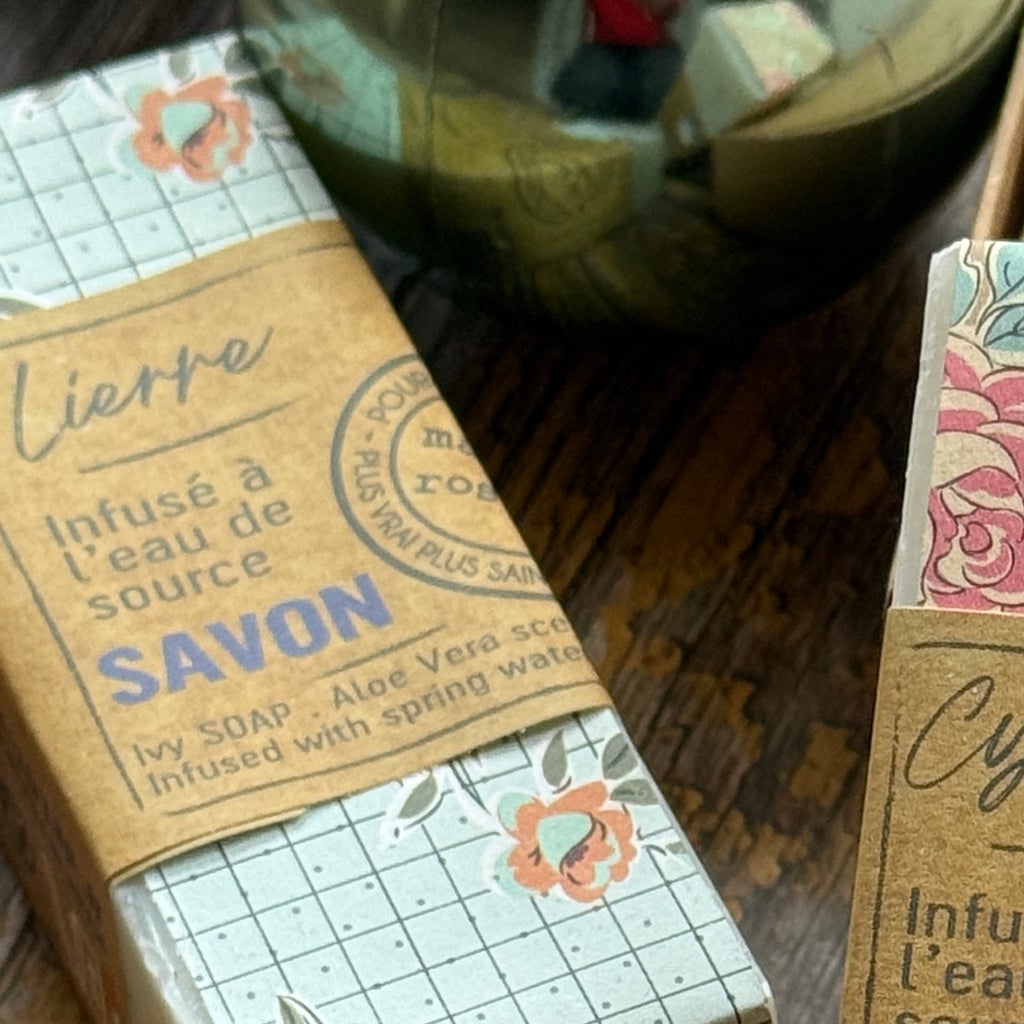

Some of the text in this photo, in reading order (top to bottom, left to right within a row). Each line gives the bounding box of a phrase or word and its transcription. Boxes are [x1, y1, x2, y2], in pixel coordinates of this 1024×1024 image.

[13, 327, 272, 463] Lierre
[46, 457, 272, 548] Infusé à
[64, 498, 294, 584] l'eau de
[354, 447, 385, 503] PLUS
[370, 501, 421, 550] VRAI
[415, 540, 480, 578] PLUS
[88, 549, 271, 621] source
[98, 572, 393, 706] SAVON
[132, 735, 183, 767] Ivy
[200, 701, 291, 743] SOAP
[332, 669, 408, 710] Aloe
[416, 633, 499, 674] Vera
[146, 742, 283, 796] Infused
[294, 716, 371, 754] with
[382, 671, 490, 726] spring
